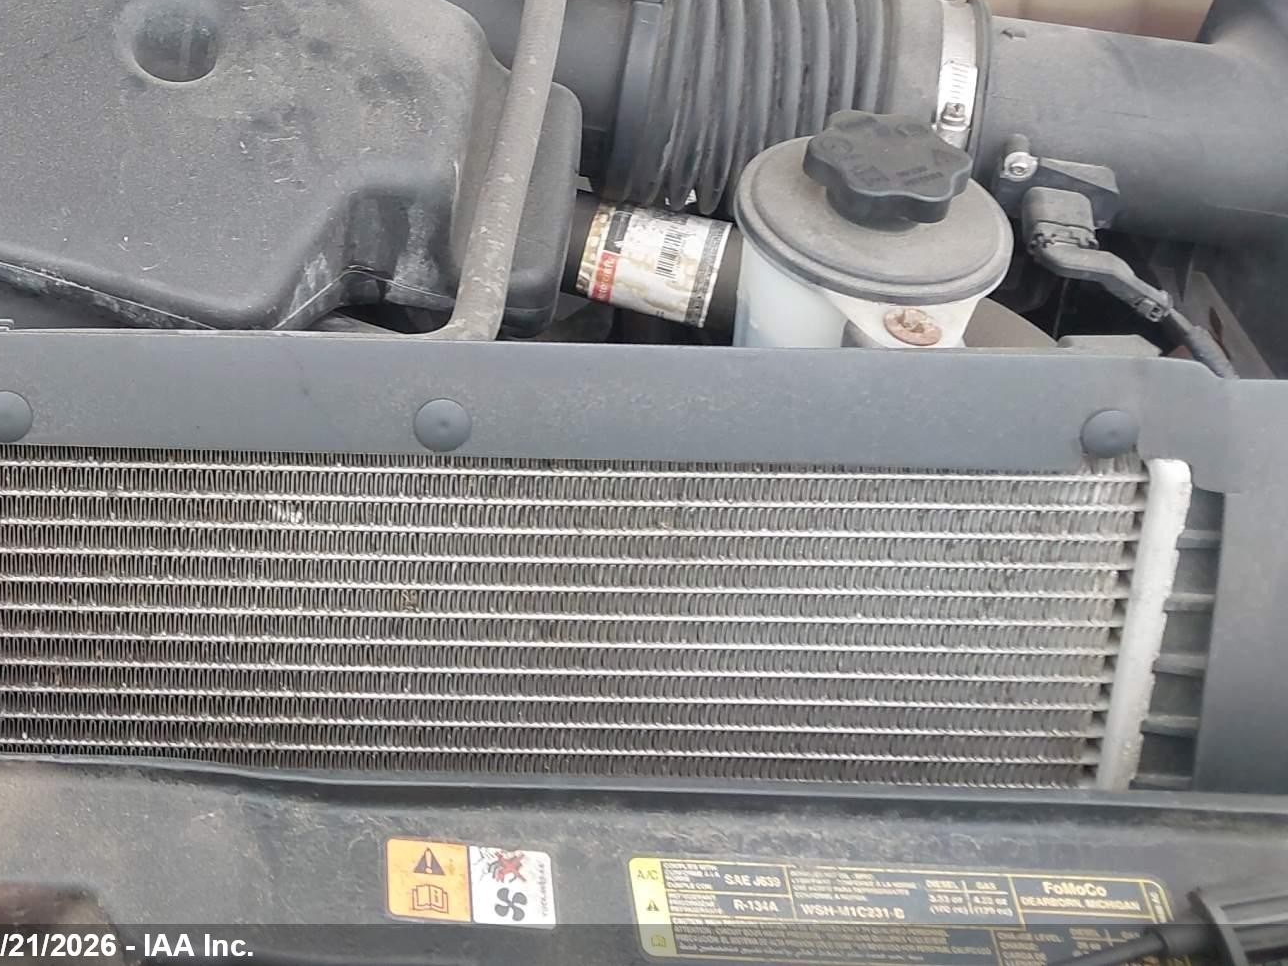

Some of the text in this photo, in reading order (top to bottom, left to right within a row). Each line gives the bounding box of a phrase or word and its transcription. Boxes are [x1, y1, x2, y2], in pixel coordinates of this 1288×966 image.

[724, 873, 751, 886] SAE
[1042, 881, 1107, 897] FoMoCo
[733, 899, 779, 912] R-134A
[1084, 899, 1141, 911] MICHIGAN
